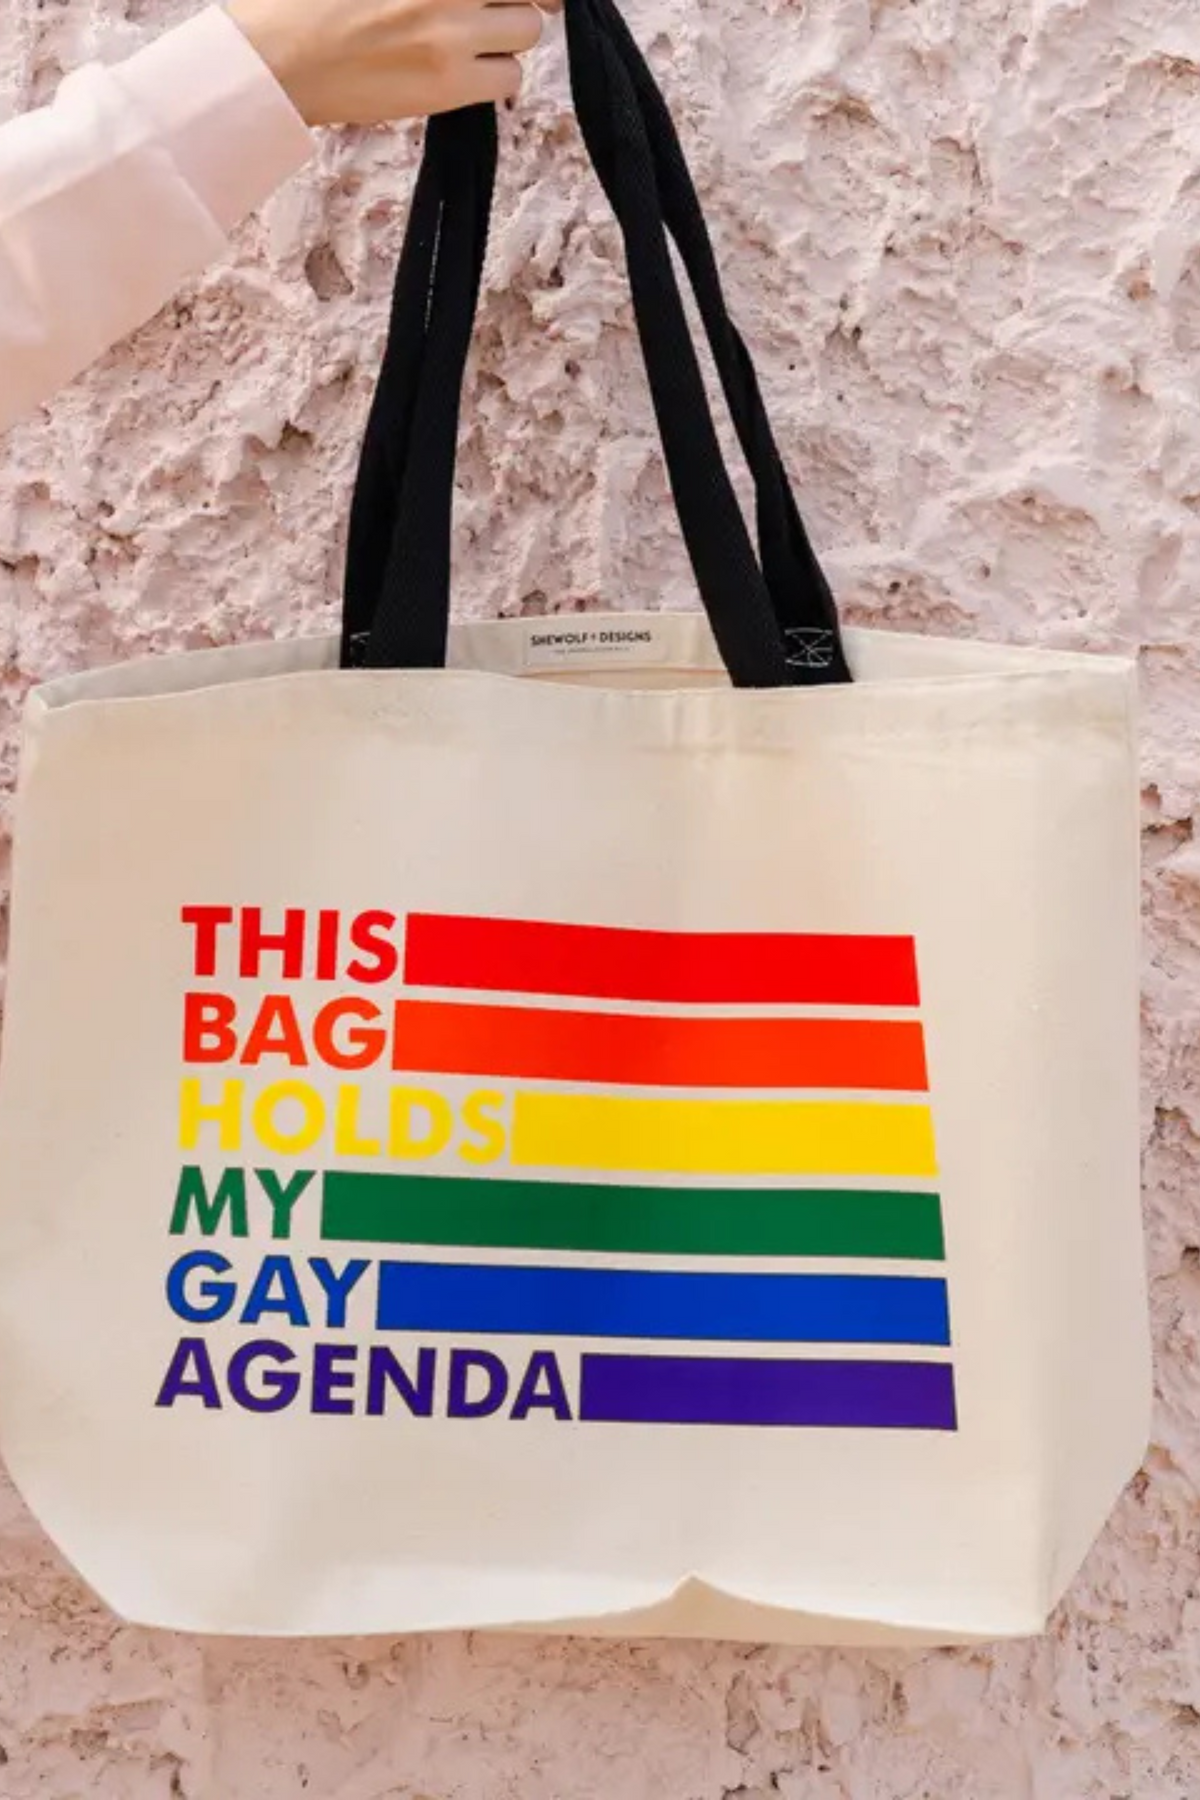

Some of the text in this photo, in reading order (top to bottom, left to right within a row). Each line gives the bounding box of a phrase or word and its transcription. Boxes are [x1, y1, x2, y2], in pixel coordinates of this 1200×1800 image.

[599, 631, 651, 643] DESIGNS
[180, 905, 399, 985] THIS
[182, 991, 388, 1071] BAG
[177, 1077, 508, 1166] HOLDS
[168, 1165, 319, 1240] MY
[165, 1249, 374, 1329] GAY
[153, 1336, 574, 1421] AGENDA
